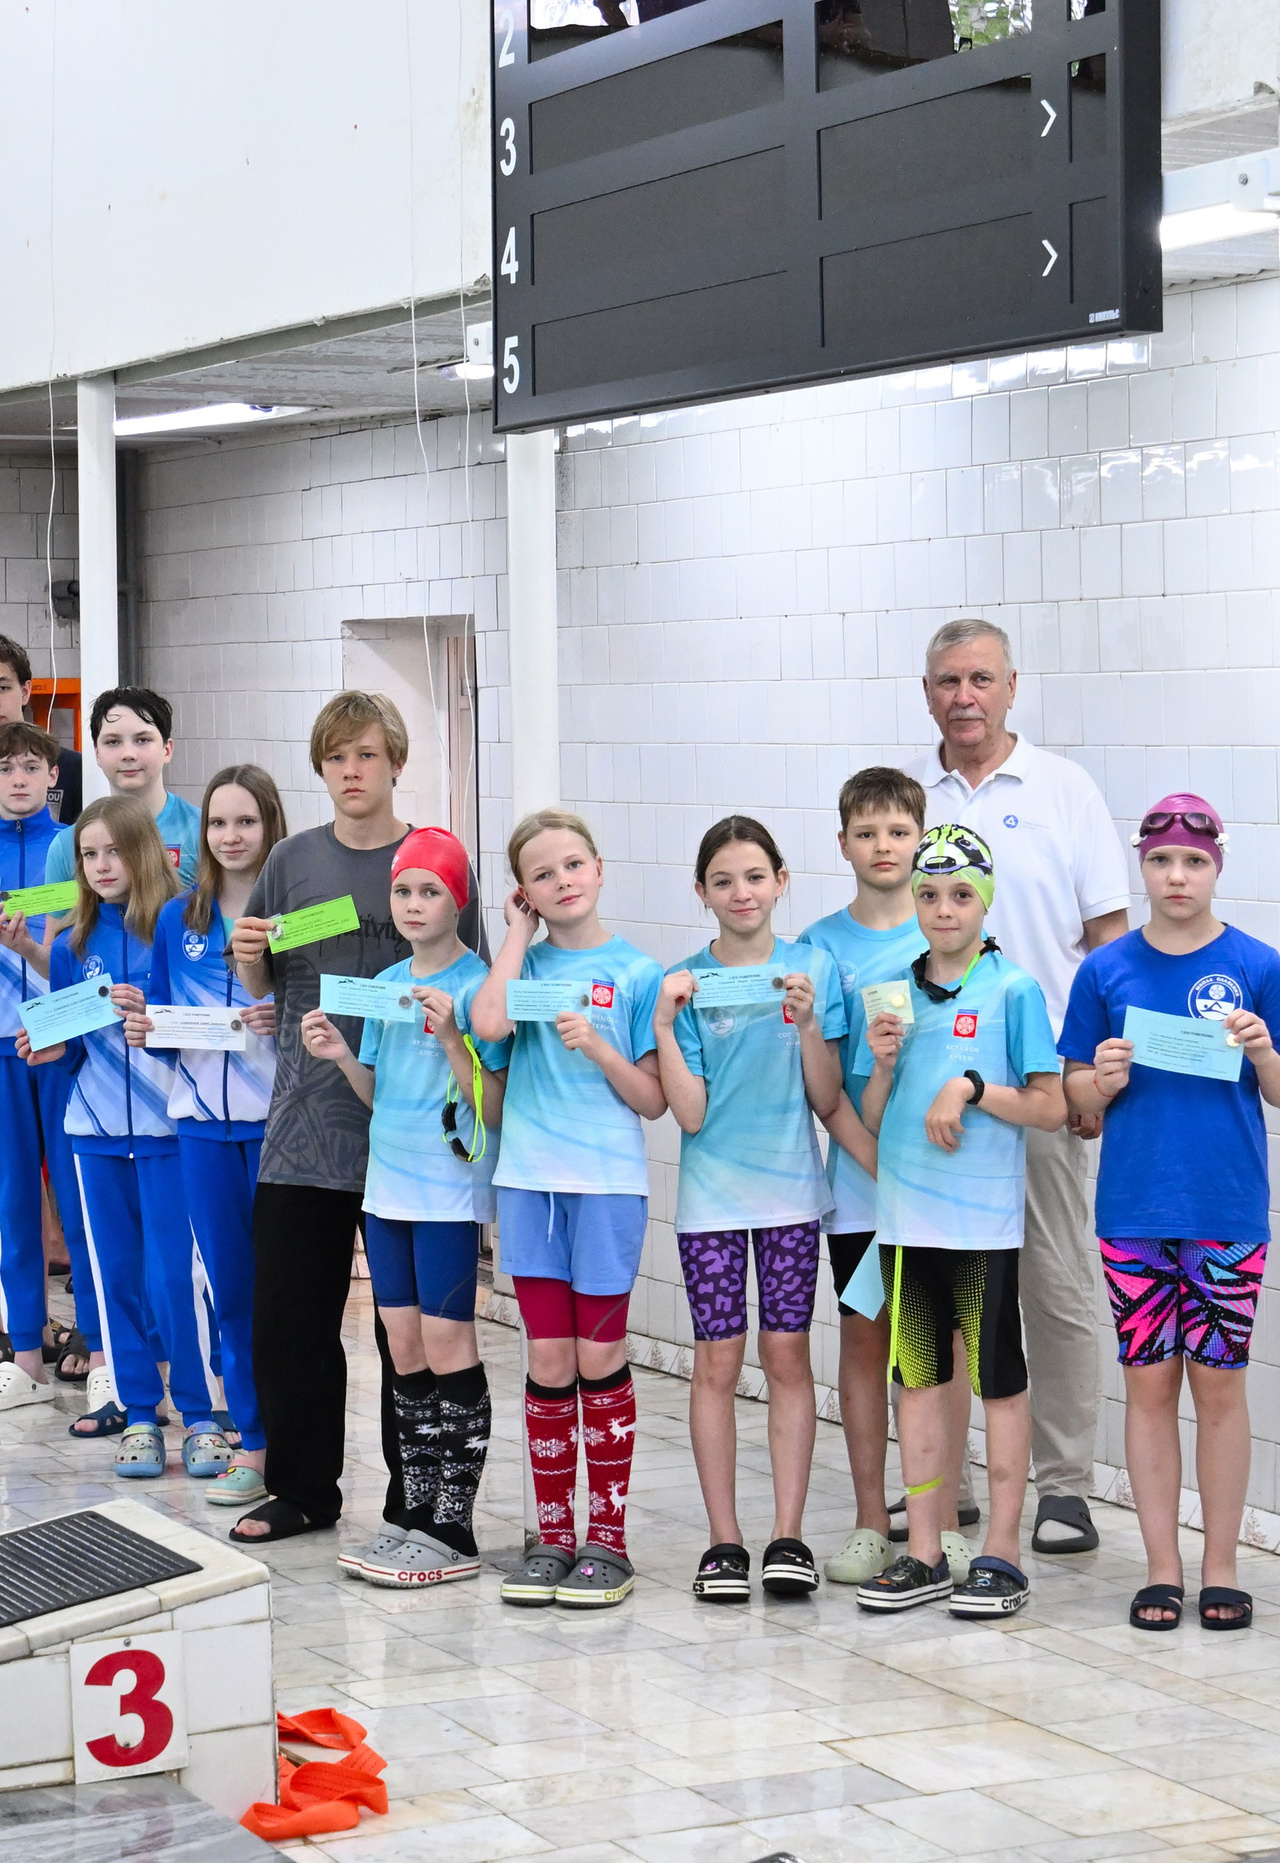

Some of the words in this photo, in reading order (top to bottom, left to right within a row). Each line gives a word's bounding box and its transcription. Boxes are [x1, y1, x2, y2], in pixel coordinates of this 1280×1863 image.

[498, 8, 516, 68] 2
[499, 116, 517, 177] 3
[500, 226, 519, 285] 4
[502, 334, 521, 395] 5
[397, 1569, 443, 1582] crocs
[84, 1649, 174, 1767] 3
